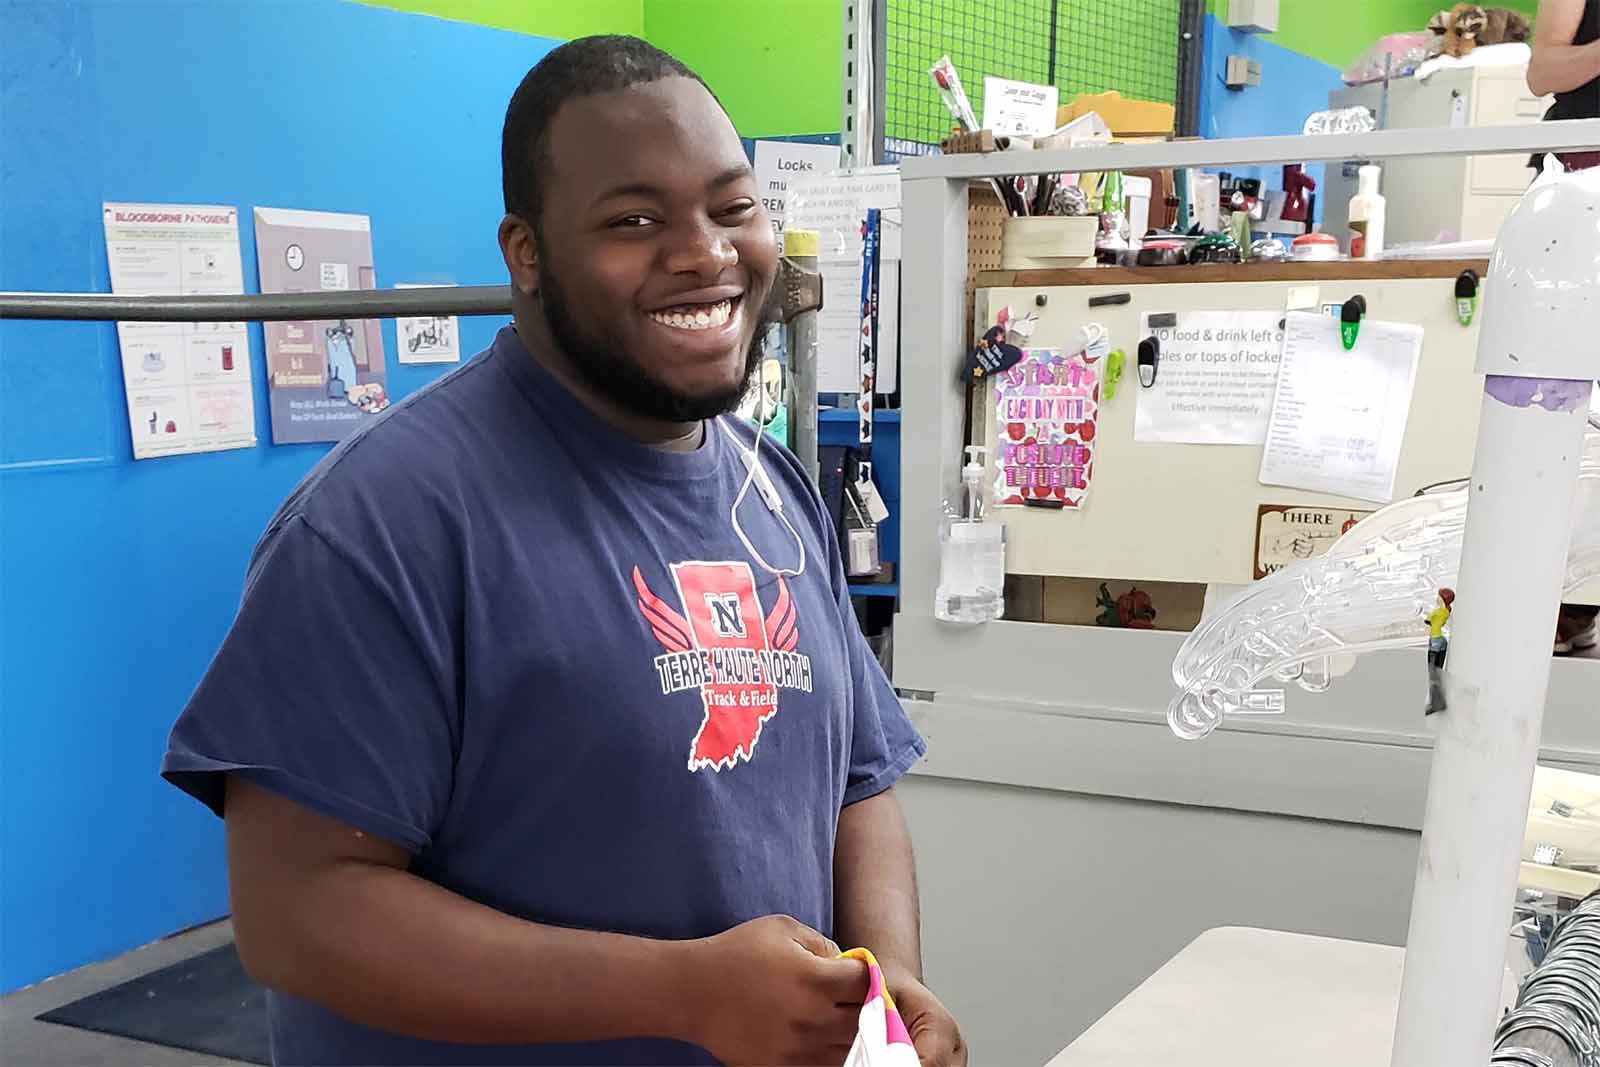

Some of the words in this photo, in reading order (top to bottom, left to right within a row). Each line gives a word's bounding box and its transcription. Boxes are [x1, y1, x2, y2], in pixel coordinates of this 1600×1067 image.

[777, 157, 813, 171] Locks
[115, 212, 182, 223] BLOODBORNE
[1173, 328, 1199, 341] food
[1203, 329, 1212, 341] &
[1216, 329, 1248, 342] drink
[1251, 328, 1272, 342] left
[1184, 352, 1198, 361] or
[1201, 351, 1227, 365] tops
[1230, 350, 1244, 362] of
[1283, 512, 1333, 525] THERE
[705, 593, 747, 637] N
[655, 651, 713, 694] TERRE
[711, 648, 760, 686] HAUTE
[760, 650, 813, 693] NORTH
[706, 688, 737, 706] Track
[739, 690, 751, 707] &
[751, 690, 778, 706] Field
